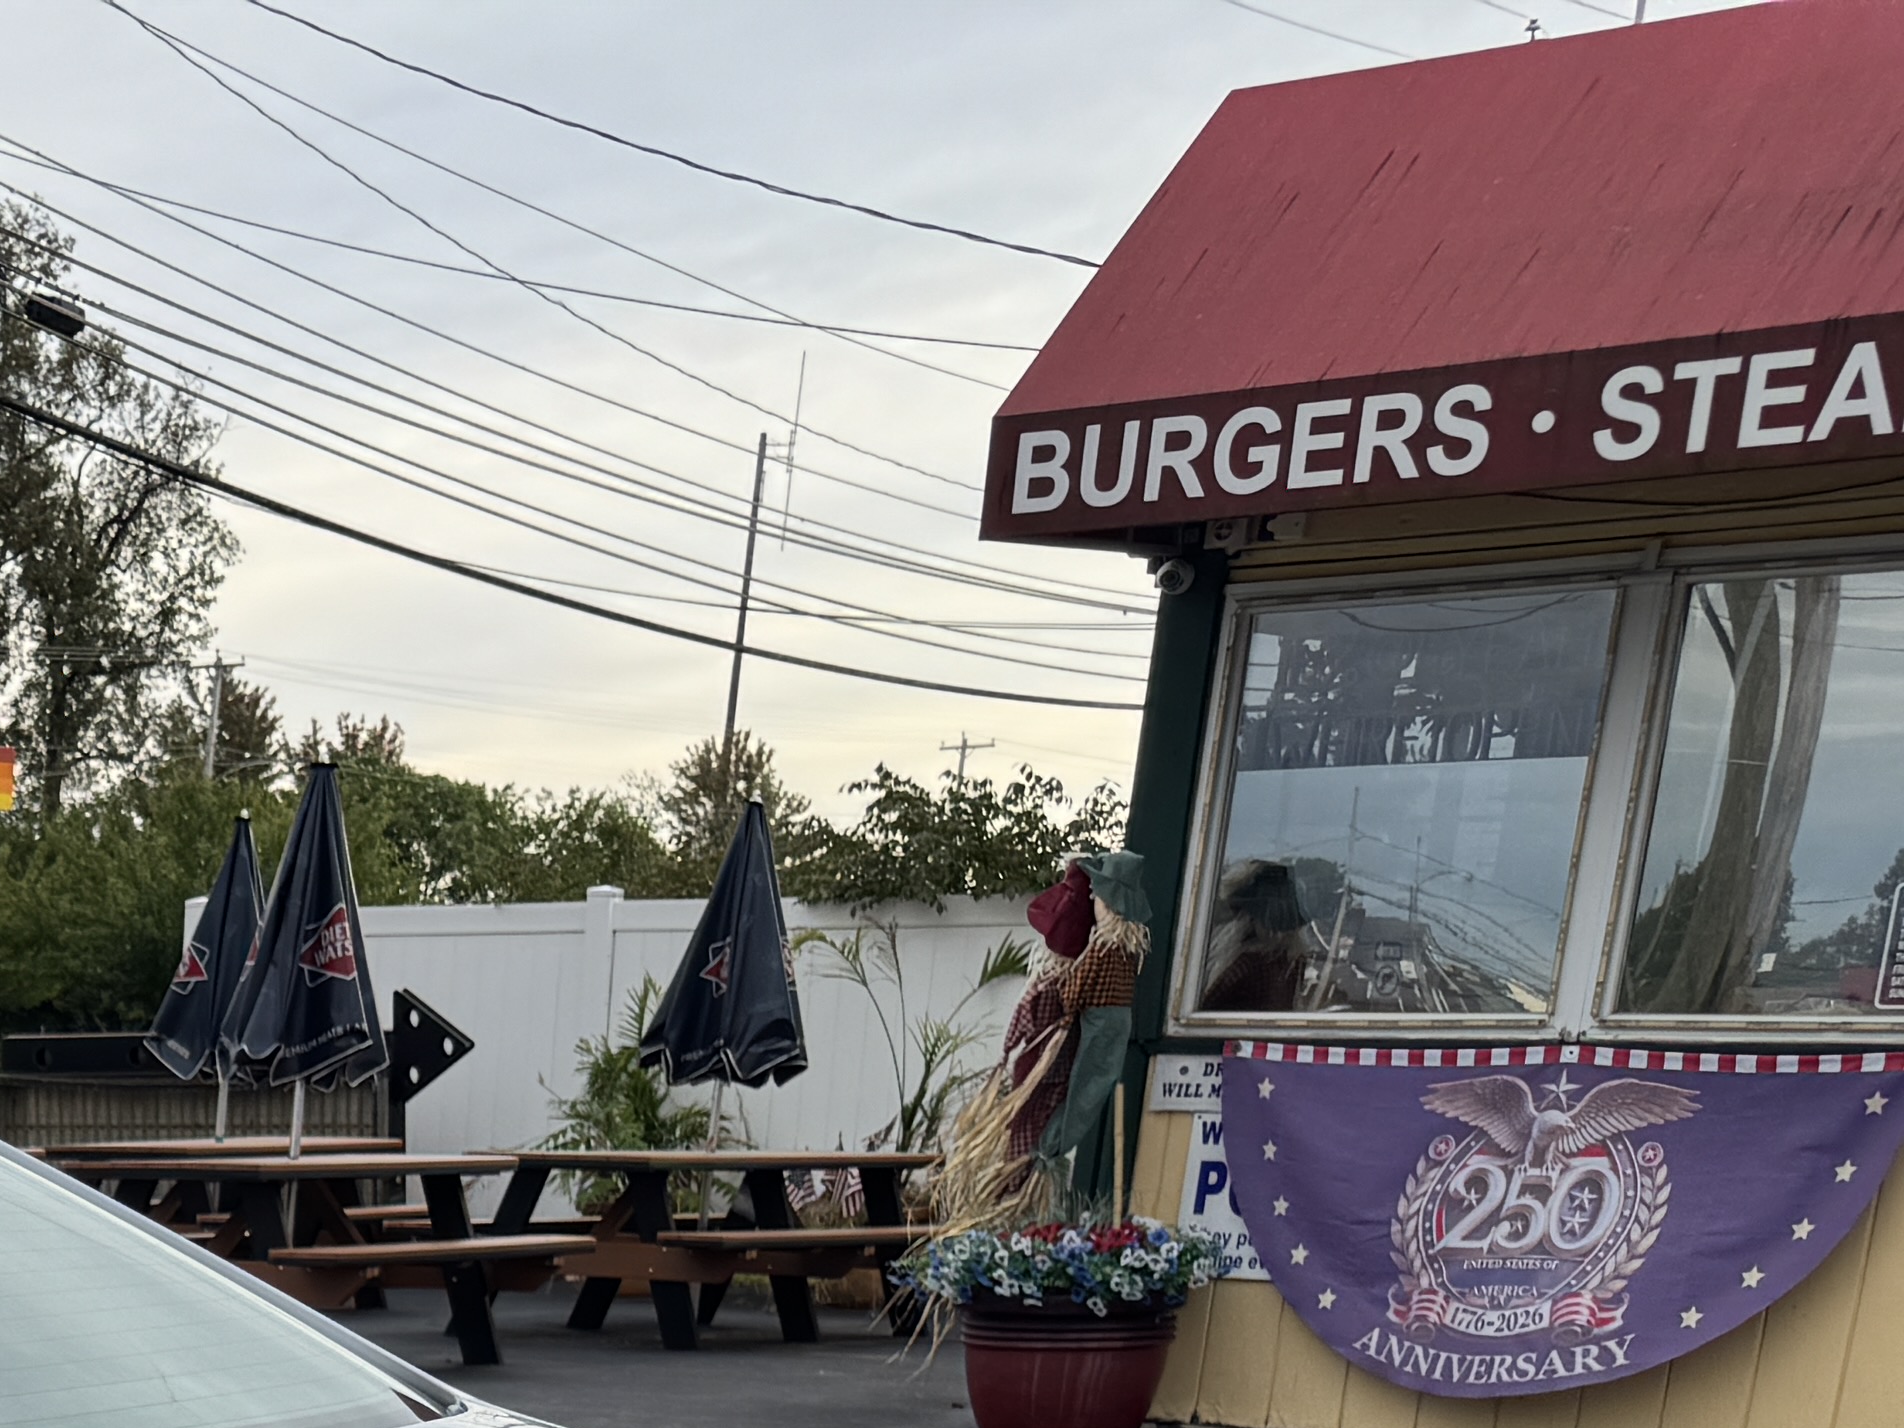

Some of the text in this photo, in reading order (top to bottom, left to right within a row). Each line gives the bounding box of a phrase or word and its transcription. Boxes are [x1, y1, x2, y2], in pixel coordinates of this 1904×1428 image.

[1010, 341, 1904, 515] BURGERS STEA
[1162, 1082, 1203, 1098] WILL
[1432, 1163, 1624, 1254] 250
[1463, 1258, 1559, 1270] UNITED STATES OF
[1471, 1284, 1539, 1297] AMERICA
[1449, 1306, 1545, 1333] 1776-2026
[1352, 1326, 1636, 1384] ANNIVERSARY
